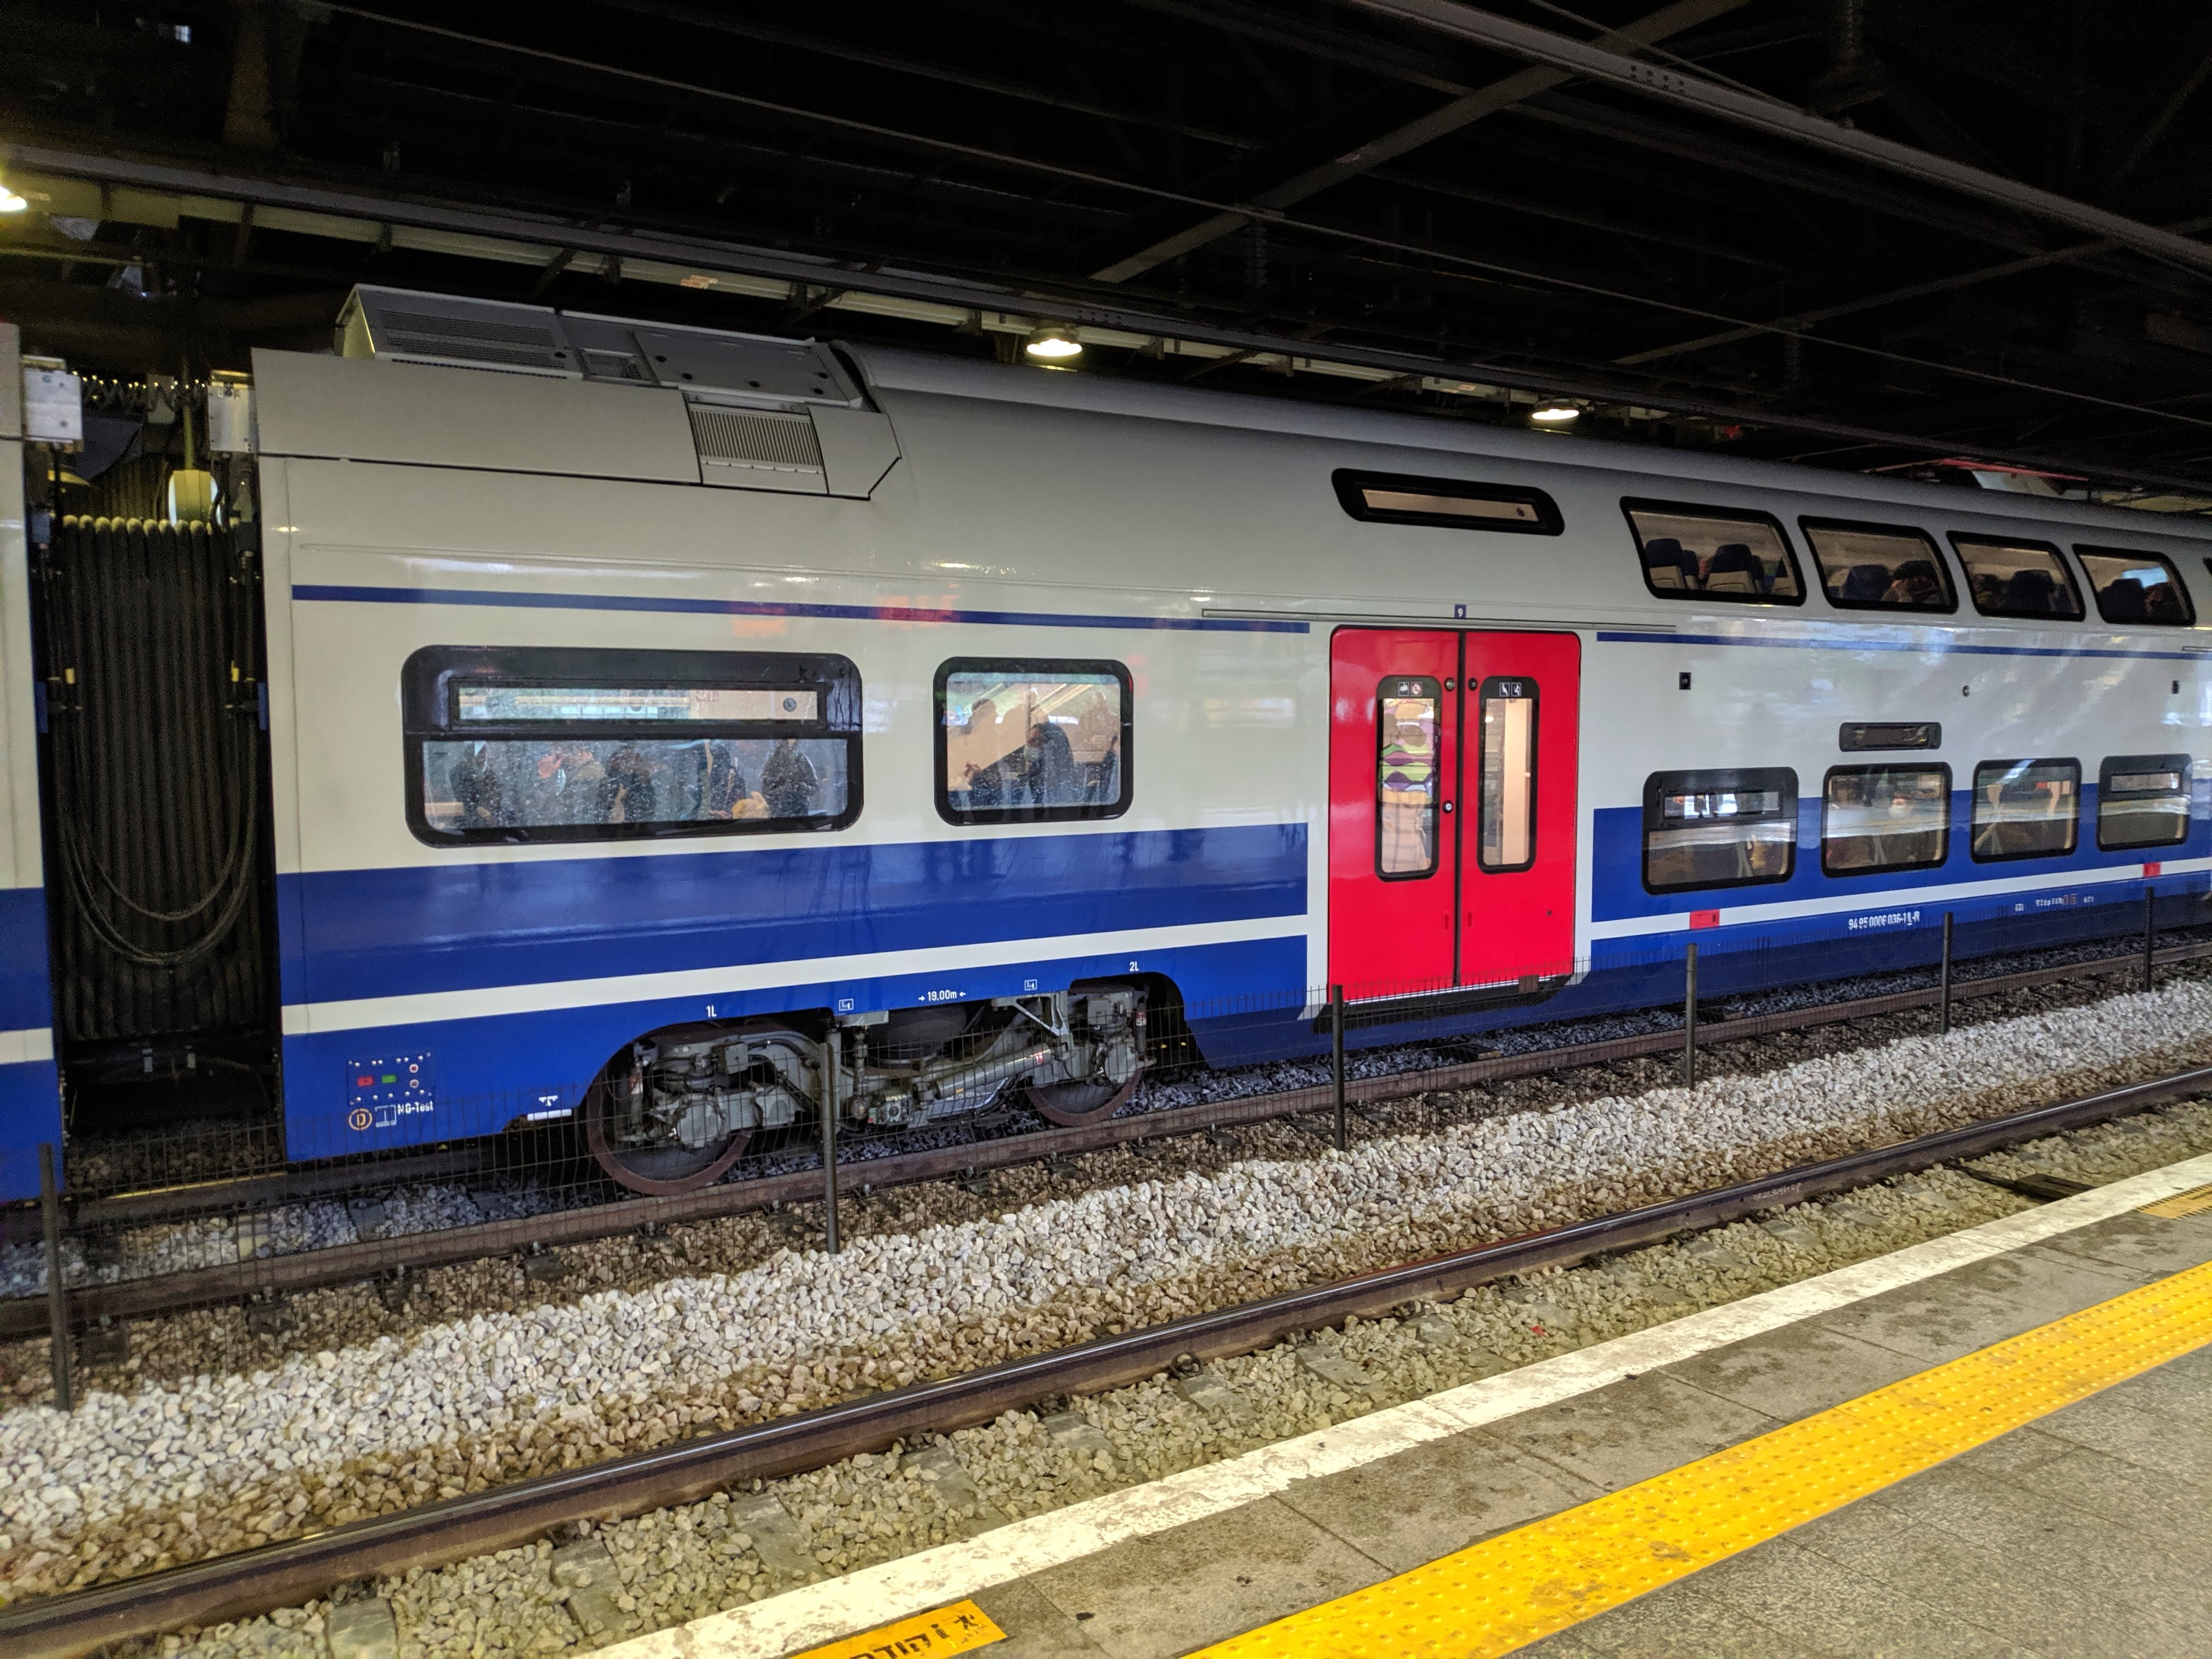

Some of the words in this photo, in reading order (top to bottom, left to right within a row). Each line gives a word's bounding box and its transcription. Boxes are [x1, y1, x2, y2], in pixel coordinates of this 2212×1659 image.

[1457, 608, 1463, 617] 9
[1848, 918, 1858, 930] 94
[1859, 917, 1868, 929] 95
[1129, 961, 1139, 972] 2L
[927, 990, 957, 1002] 19.00m
[706, 1005, 717, 1018] 1L
